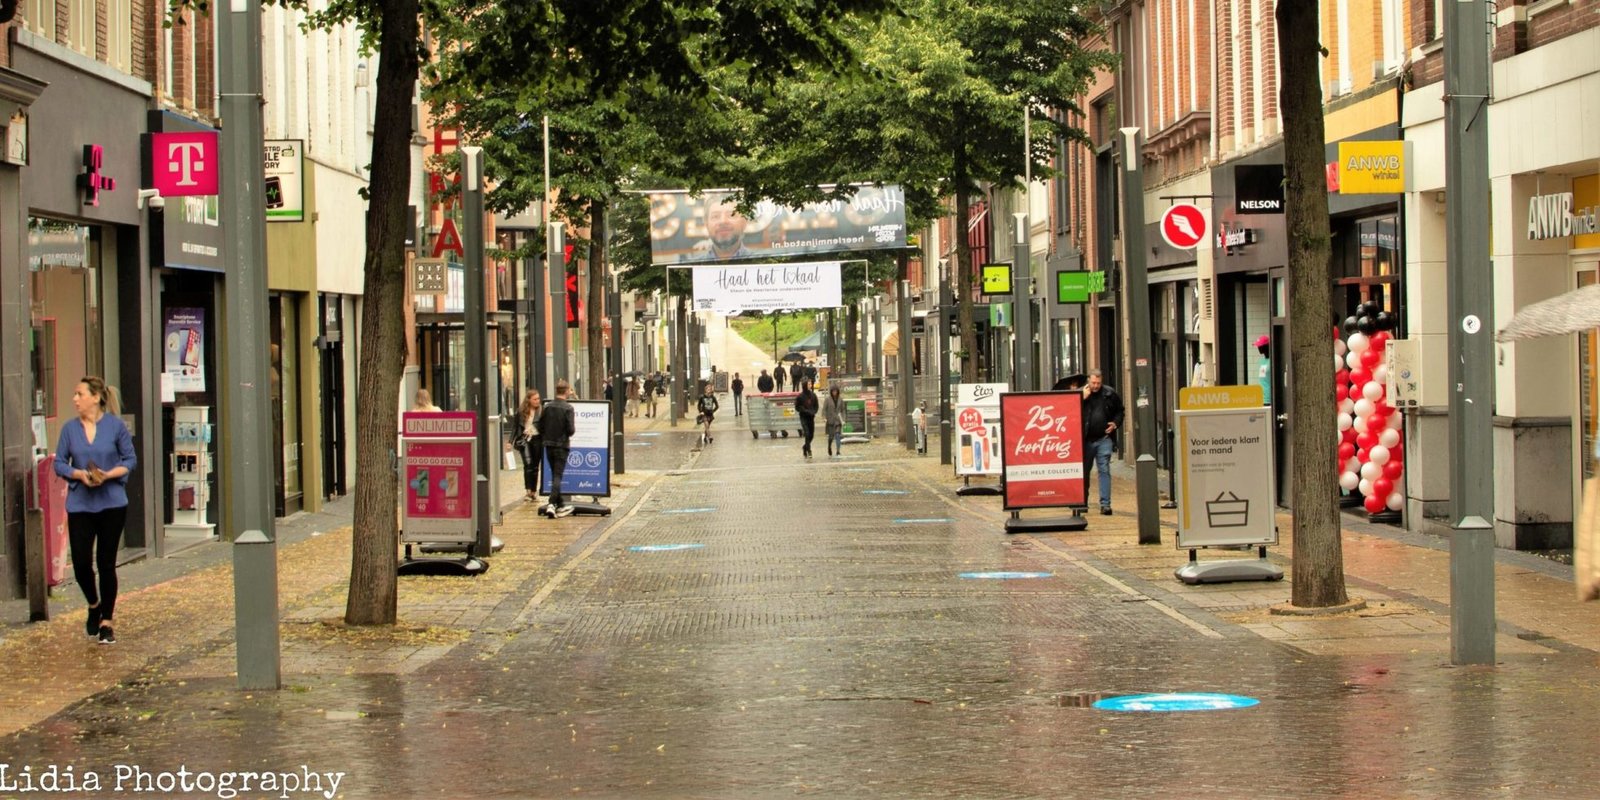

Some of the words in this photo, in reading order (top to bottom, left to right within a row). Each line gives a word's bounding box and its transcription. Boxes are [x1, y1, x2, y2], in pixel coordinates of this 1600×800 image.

[1347, 157, 1400, 170] ANWB
[1372, 171, 1400, 180] winkel
[1240, 200, 1280, 209] NELSON
[1528, 193, 1573, 240] ANWB
[714, 269, 750, 289] Haal
[756, 268, 780, 285] het
[974, 385, 994, 400] Etos
[1187, 392, 1231, 406] ANWB
[962, 412, 979, 422] 1+1
[1025, 405, 1068, 433] 25%
[407, 420, 472, 432] UNLIMITED
[1015, 434, 1072, 459] korting
[1191, 438, 1209, 447] Voor
[1211, 436, 1238, 446] iedere
[1239, 436, 1260, 444] klant
[1209, 446, 1233, 454] mand
[1047, 467, 1080, 475] COLLECTIE
